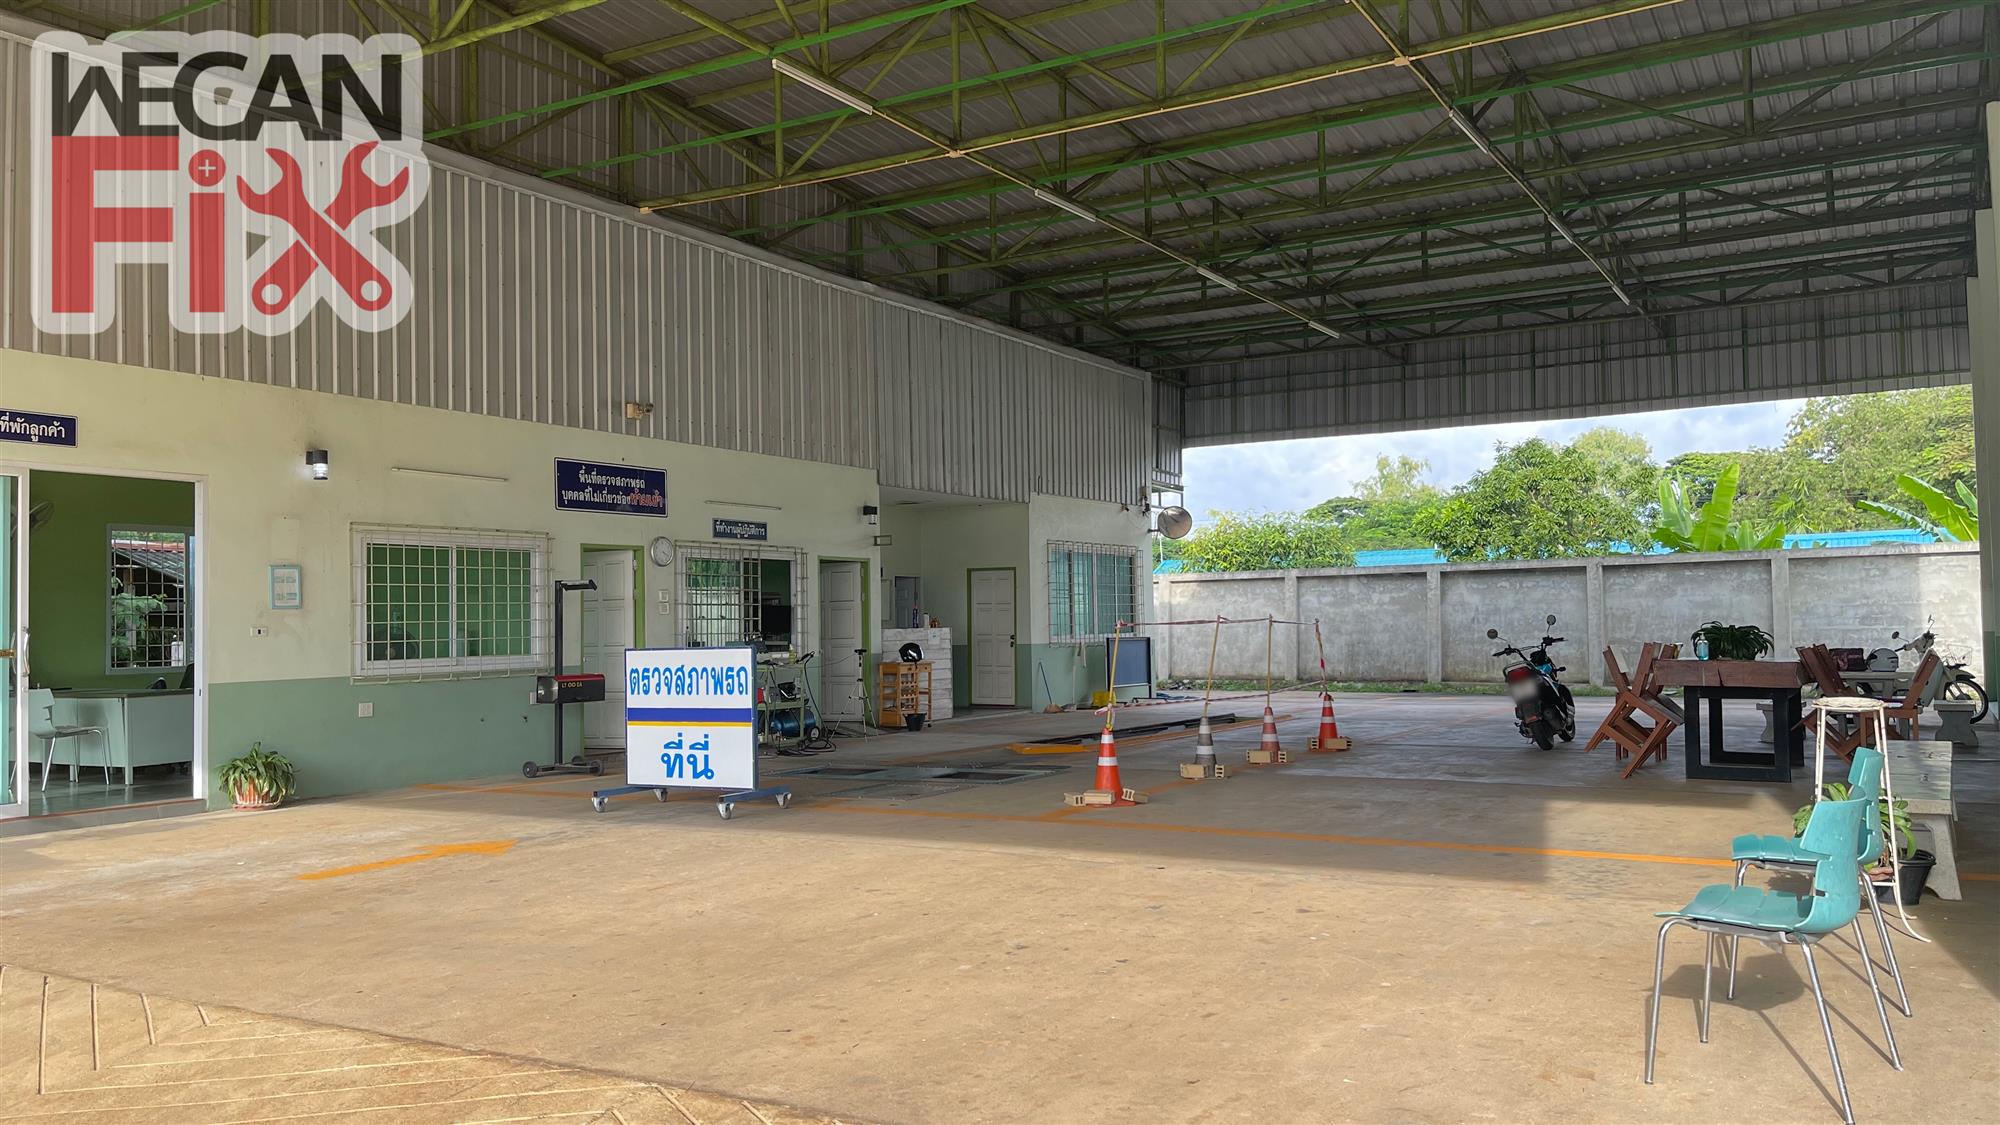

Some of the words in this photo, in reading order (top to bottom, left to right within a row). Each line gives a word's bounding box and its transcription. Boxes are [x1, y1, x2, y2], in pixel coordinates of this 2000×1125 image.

[578, 466, 645, 489] พื้นที่ตรวจสภาพรถ
[629, 664, 748, 696] ตรวจสภาพรถ
[661, 732, 715, 780] ที่นี่
